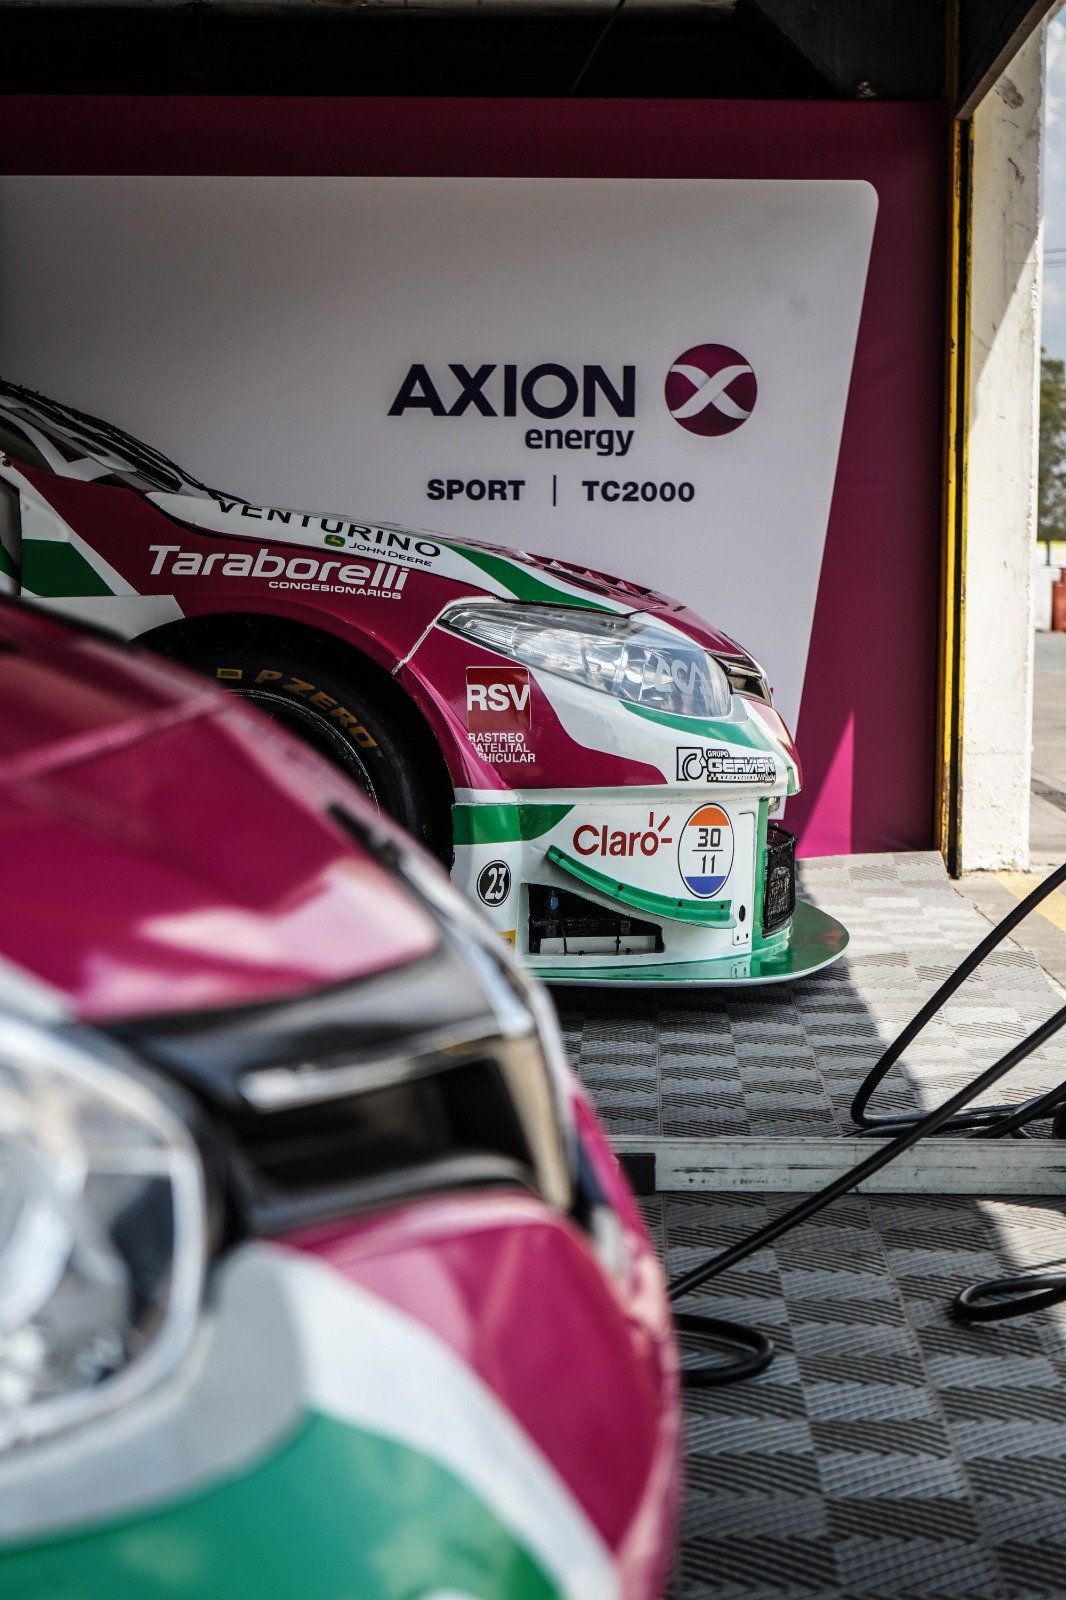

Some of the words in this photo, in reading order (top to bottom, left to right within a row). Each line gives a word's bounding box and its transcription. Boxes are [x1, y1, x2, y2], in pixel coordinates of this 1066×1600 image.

[386, 363, 636, 420] AXION
[524, 428, 635, 457] energy
[426, 478, 526, 502] SPORT
[581, 480, 696, 503] TC2000
[218, 500, 441, 558] VENTURINO
[148, 544, 410, 591] Taraborelli
[268, 580, 402, 600] CONCESIONARIOS
[466, 684, 530, 711] RSV
[468, 732, 525, 743] RASTREO
[472, 742, 531, 753] ATELITAL
[707, 750, 729, 758] GRUPO
[572, 823, 659, 857] Claro
[697, 827, 722, 848] 30
[701, 854, 715, 874] 11
[486, 867, 507, 901] 23
